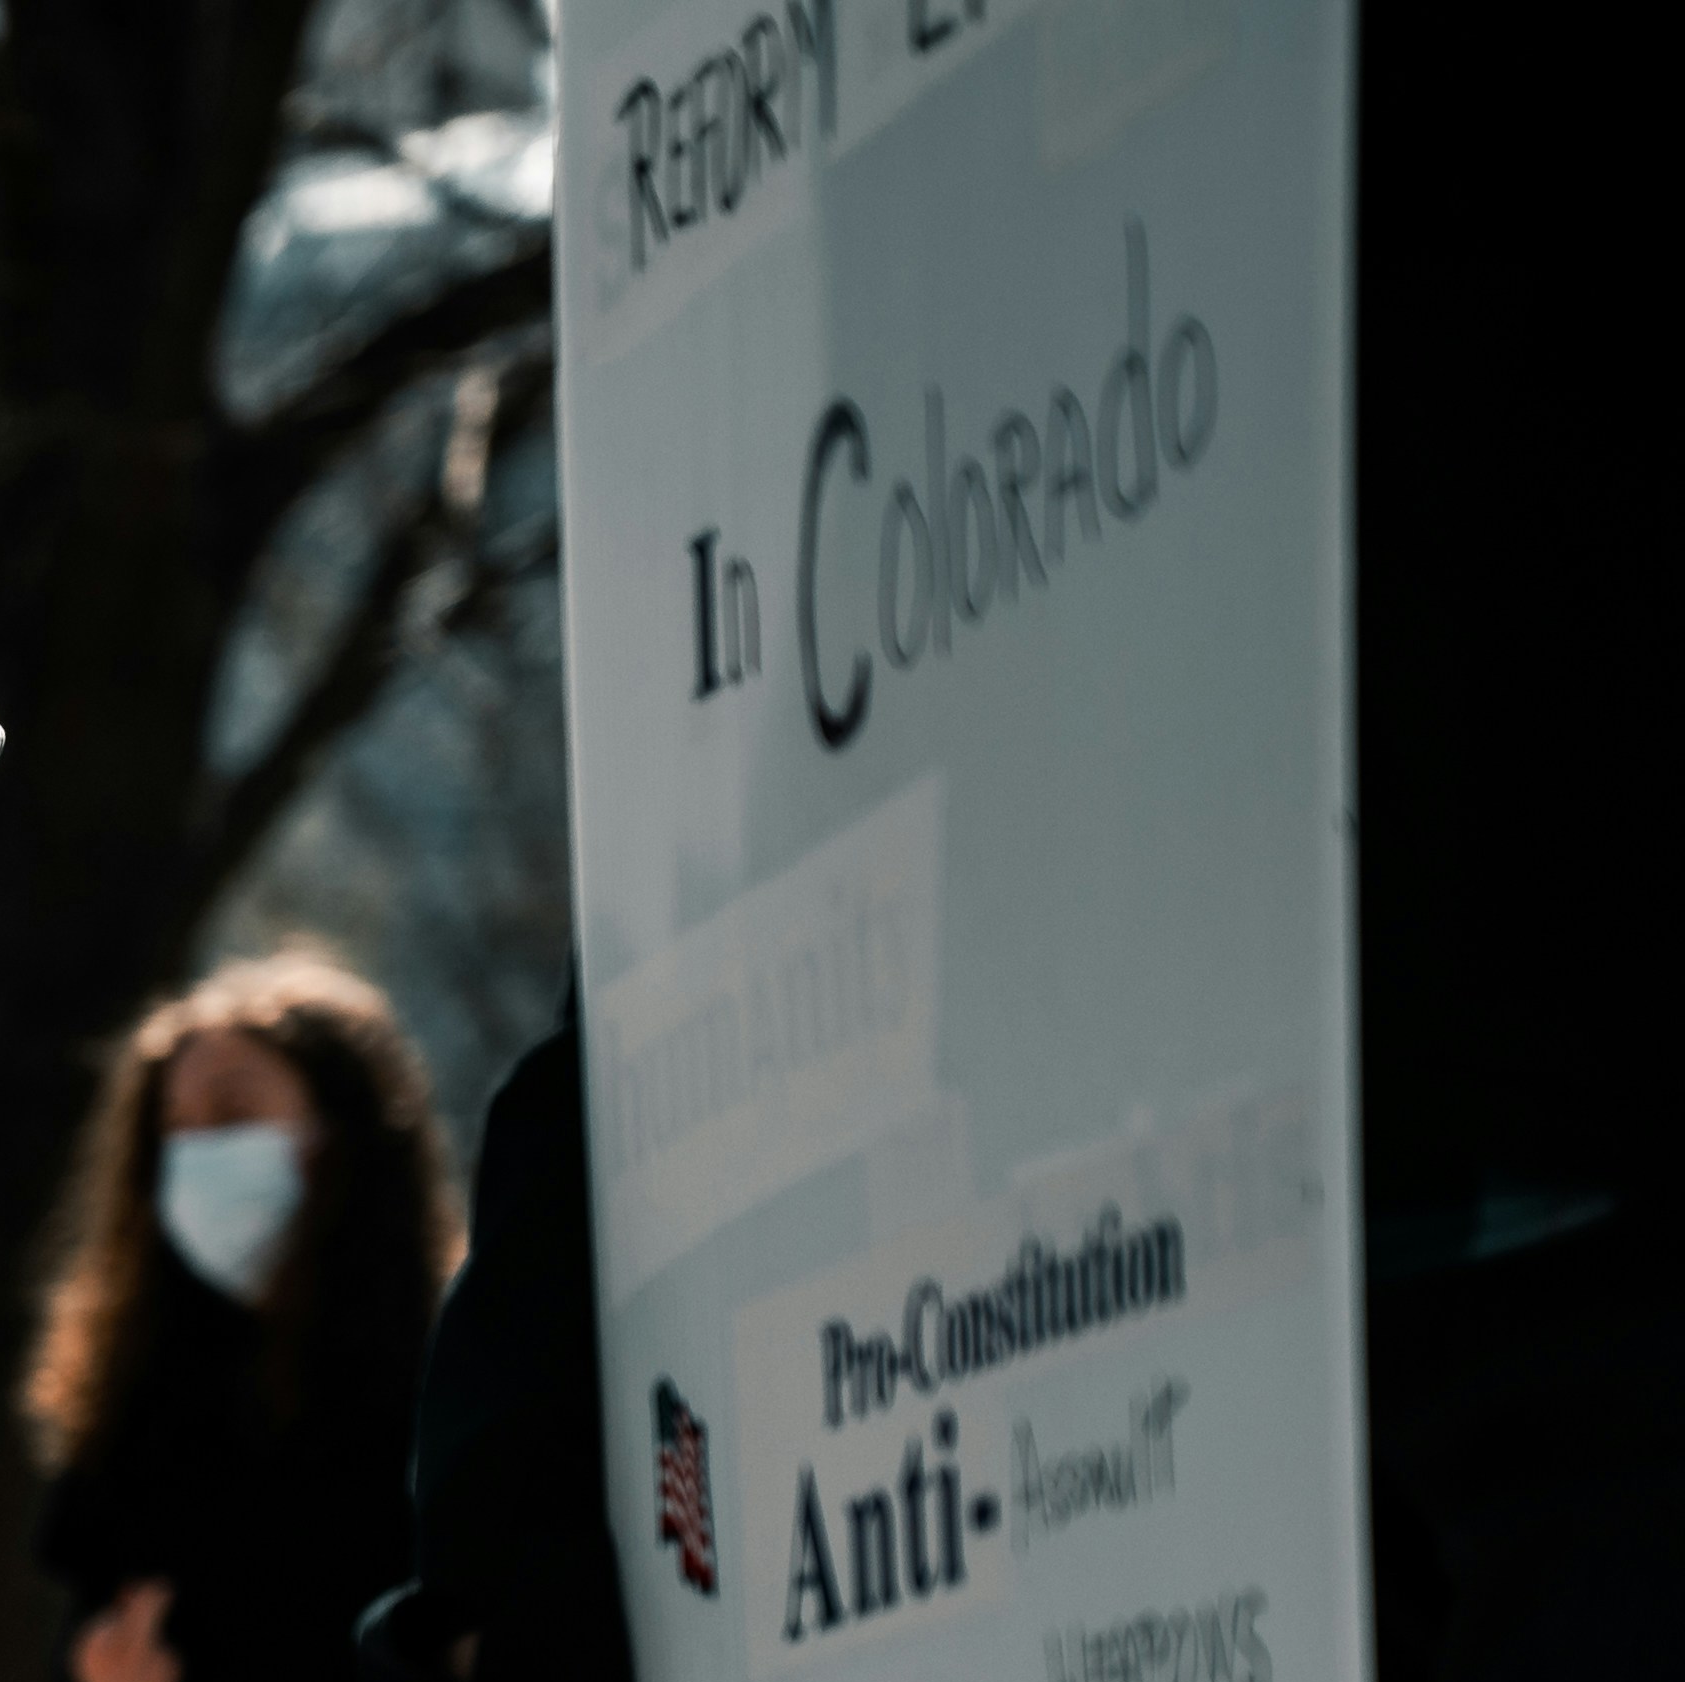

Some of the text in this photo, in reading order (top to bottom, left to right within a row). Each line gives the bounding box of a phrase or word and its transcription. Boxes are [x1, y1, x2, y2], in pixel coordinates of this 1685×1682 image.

[688, 525, 762, 703] In
[819, 1201, 1187, 1431] Pro-Constitution
[782, 1404, 1002, 1643] Anti-
